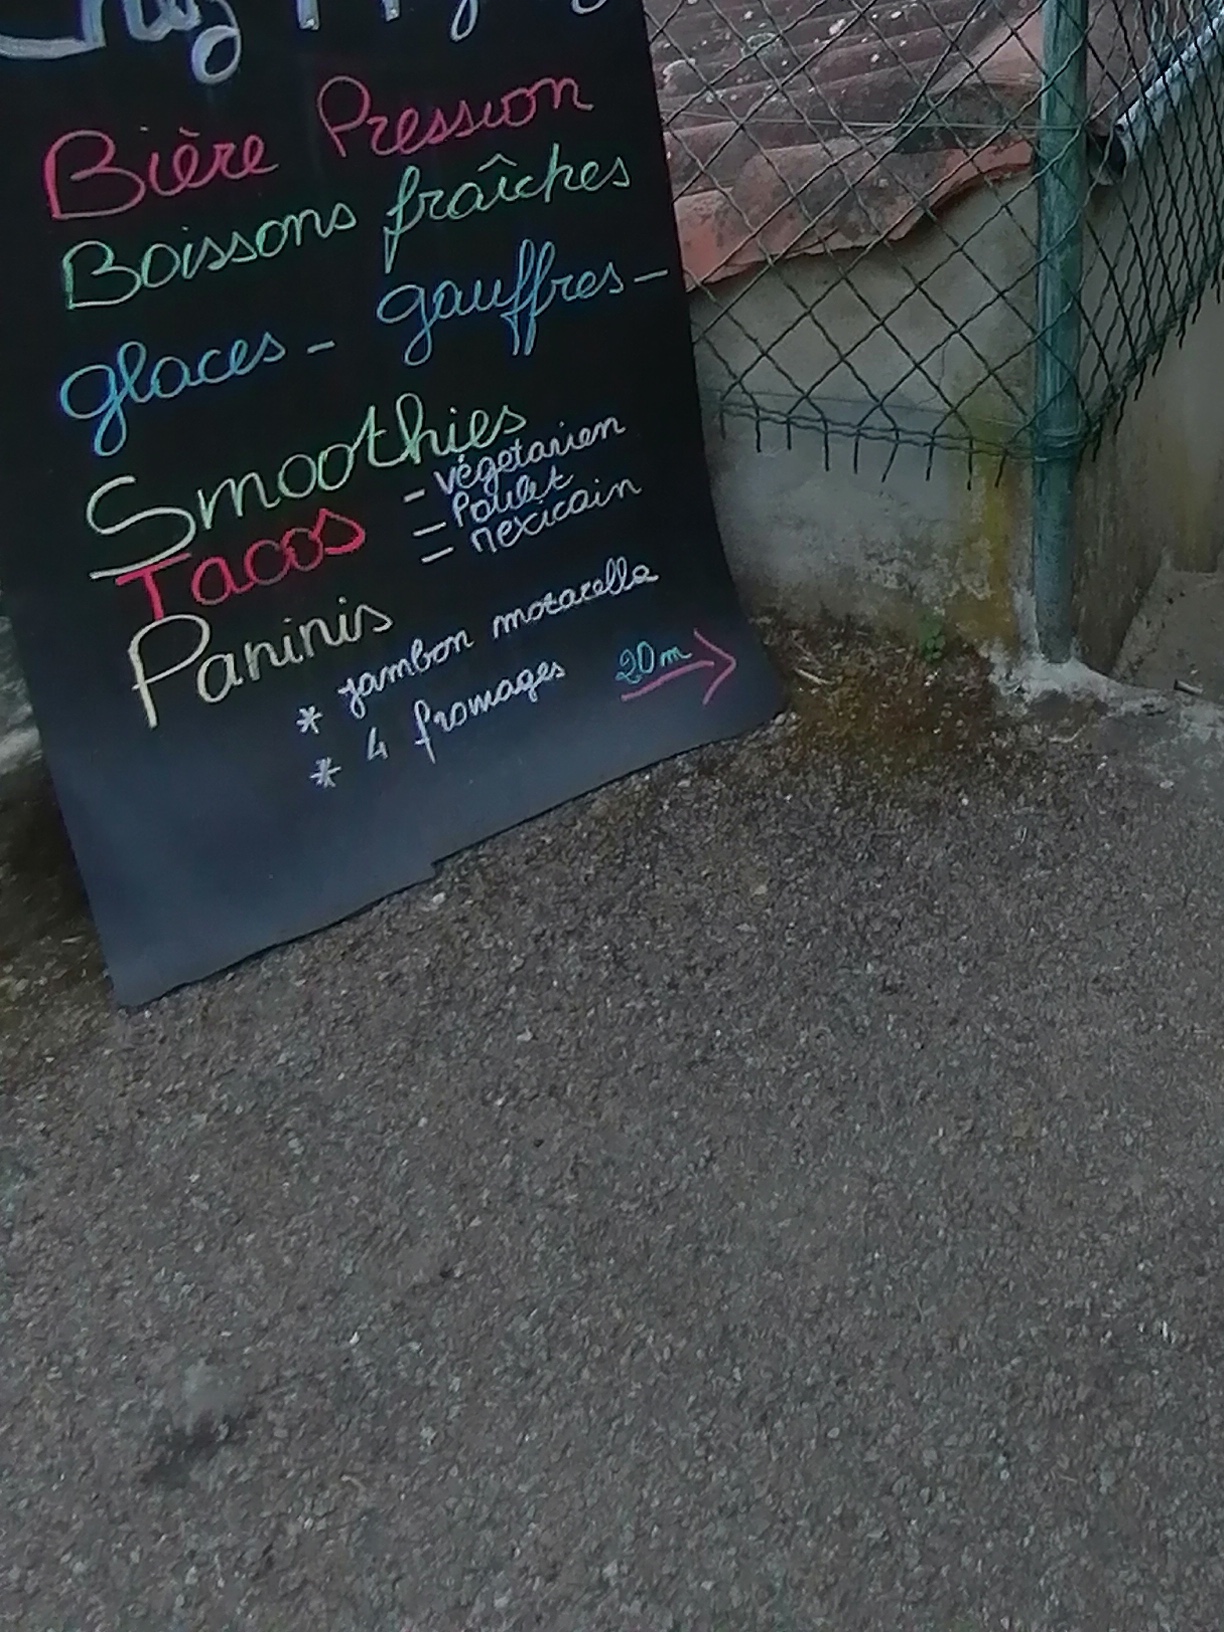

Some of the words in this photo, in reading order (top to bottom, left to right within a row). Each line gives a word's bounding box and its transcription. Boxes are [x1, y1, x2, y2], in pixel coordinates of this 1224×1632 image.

[44, 125, 279, 221] Bière
[317, 75, 595, 158] Pression
[62, 200, 358, 311] Boissons
[383, 142, 631, 275] fraîches
[59, 331, 287, 457] glaces
[85, 391, 528, 580] Smoothies
[115, 506, 367, 621] Tacos
[126, 596, 394, 730] Paninis
[365, 724, 390, 763] 4
[413, 659, 567, 765] fromages
